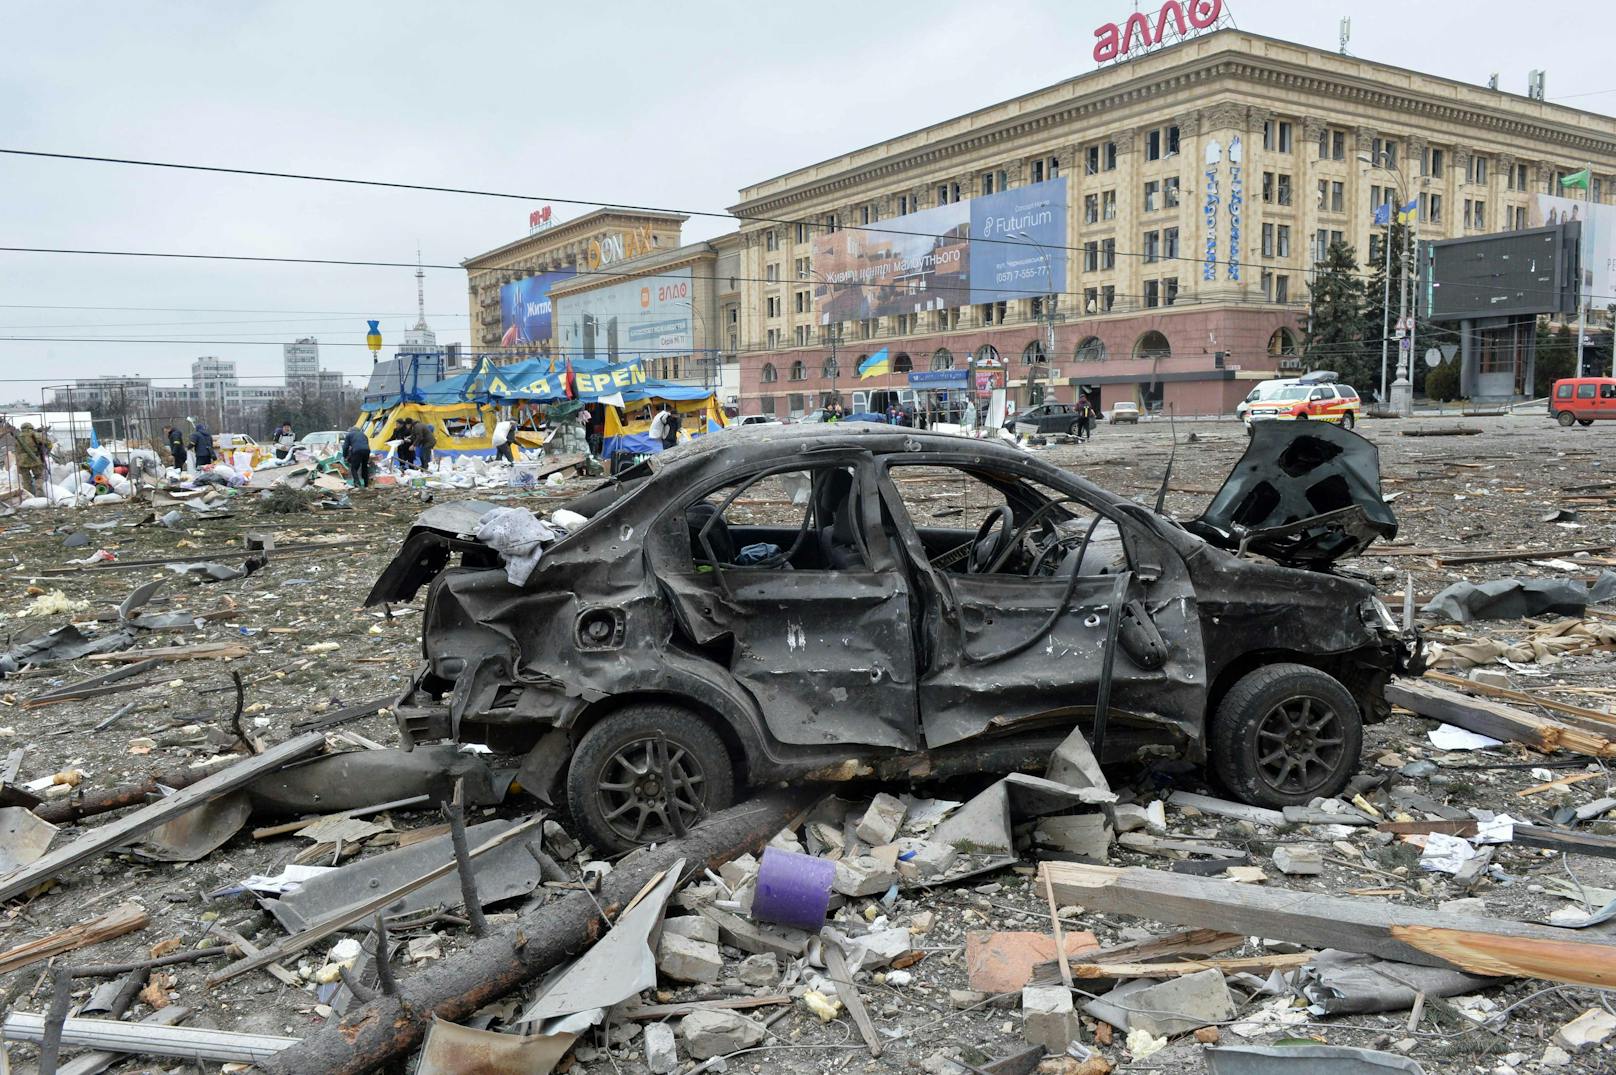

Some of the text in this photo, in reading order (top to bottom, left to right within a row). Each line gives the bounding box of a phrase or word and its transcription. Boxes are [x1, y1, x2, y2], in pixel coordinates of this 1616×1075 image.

[1093, 0, 1222, 62] алло
[996, 210, 1052, 233] Futurium
[658, 282, 688, 302] алло
